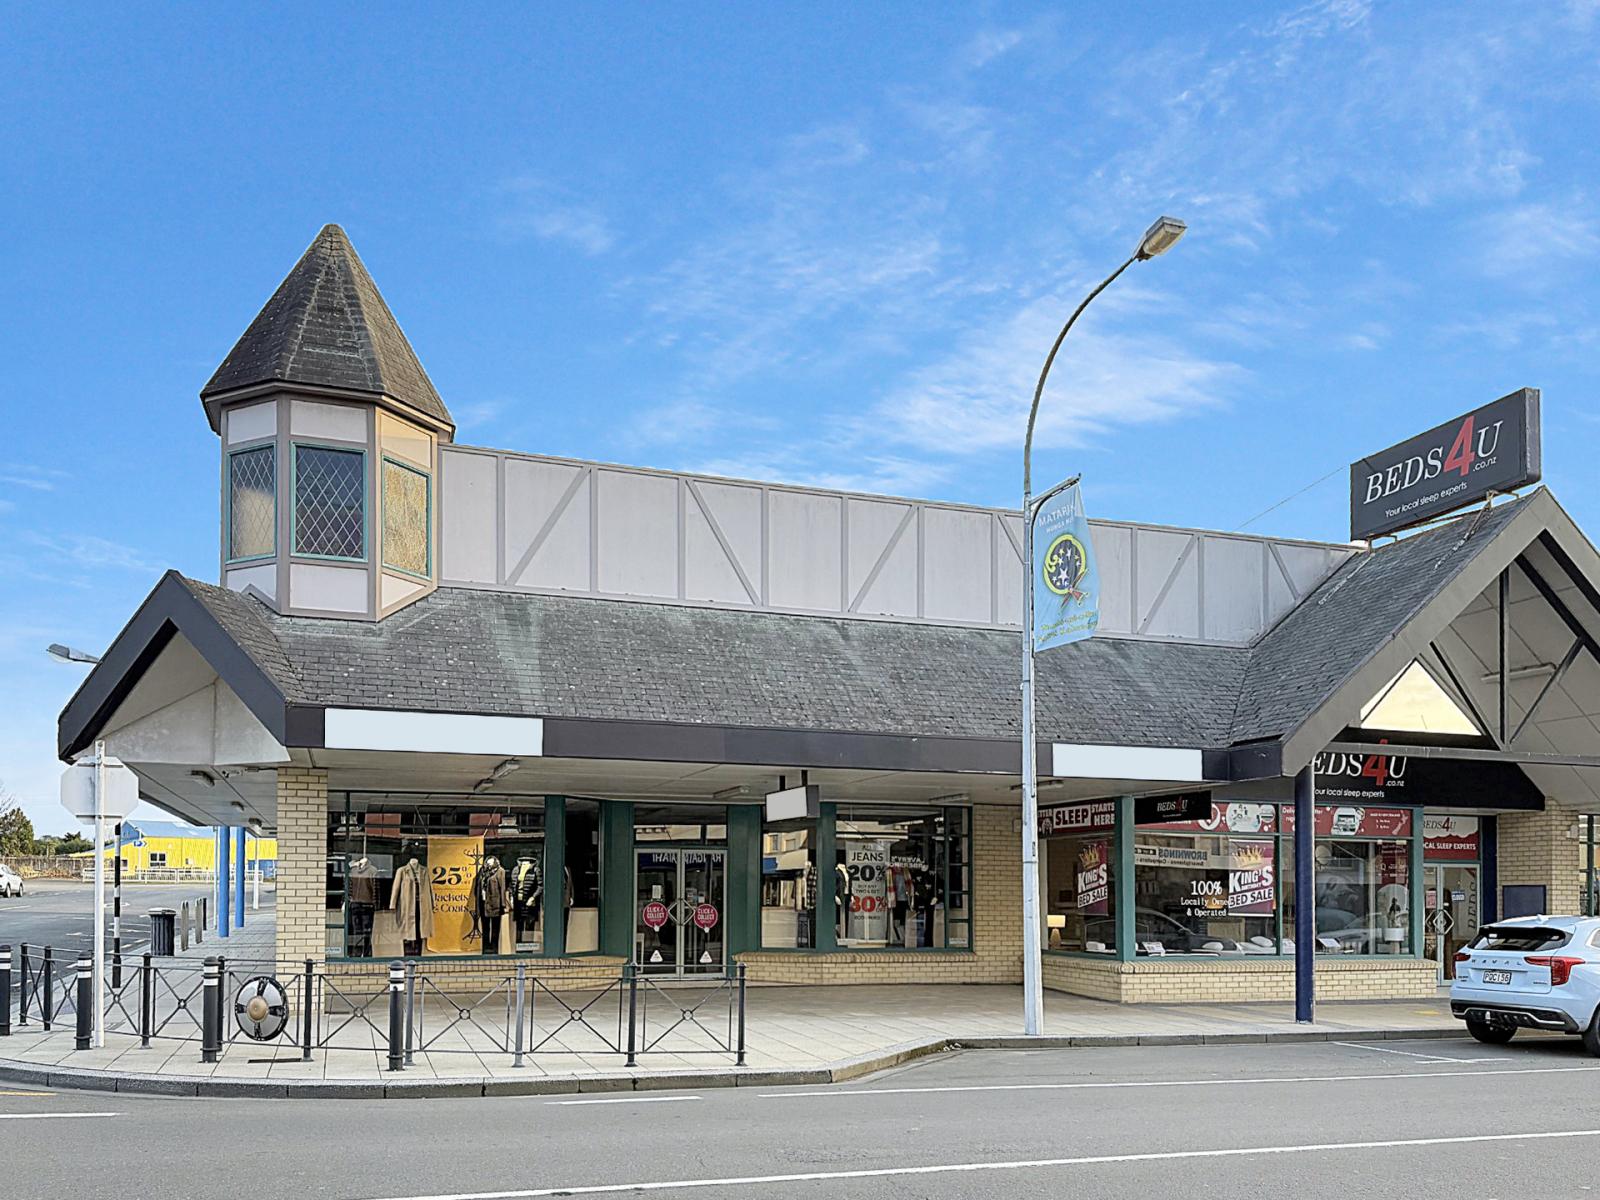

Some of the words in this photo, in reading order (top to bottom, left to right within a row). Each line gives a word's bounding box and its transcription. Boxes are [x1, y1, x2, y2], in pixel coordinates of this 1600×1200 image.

[1363, 415, 1504, 504] BEDS4U
[1472, 456, 1497, 472] .co.nz
[1385, 506, 1402, 518] Your
[1401, 499, 1420, 513] local
[1420, 492, 1439, 506] sleep
[1440, 481, 1468, 498] experts
[1313, 739, 1407, 786] EDS4U
[1314, 788, 1326, 796] our
[1326, 788, 1343, 796] local
[1344, 789, 1361, 798] sleep
[1362, 789, 1385, 799] experts
[1055, 807, 1089, 826] SLEEP
[1092, 802, 1115, 813] STARTS
[1094, 814, 1115, 826] HERE
[852, 852, 884, 862] JEANS
[848, 864, 886, 881] 20%
[1190, 880, 1222, 896] 100%
[1079, 893, 1091, 907] BED
[1092, 888, 1107, 901] SALE
[1180, 896, 1208, 908] Locally
[1230, 894, 1248, 907] BED
[1250, 888, 1272, 902] SALE
[1186, 908, 1192, 916] &
[1194, 908, 1227, 918] Operated
